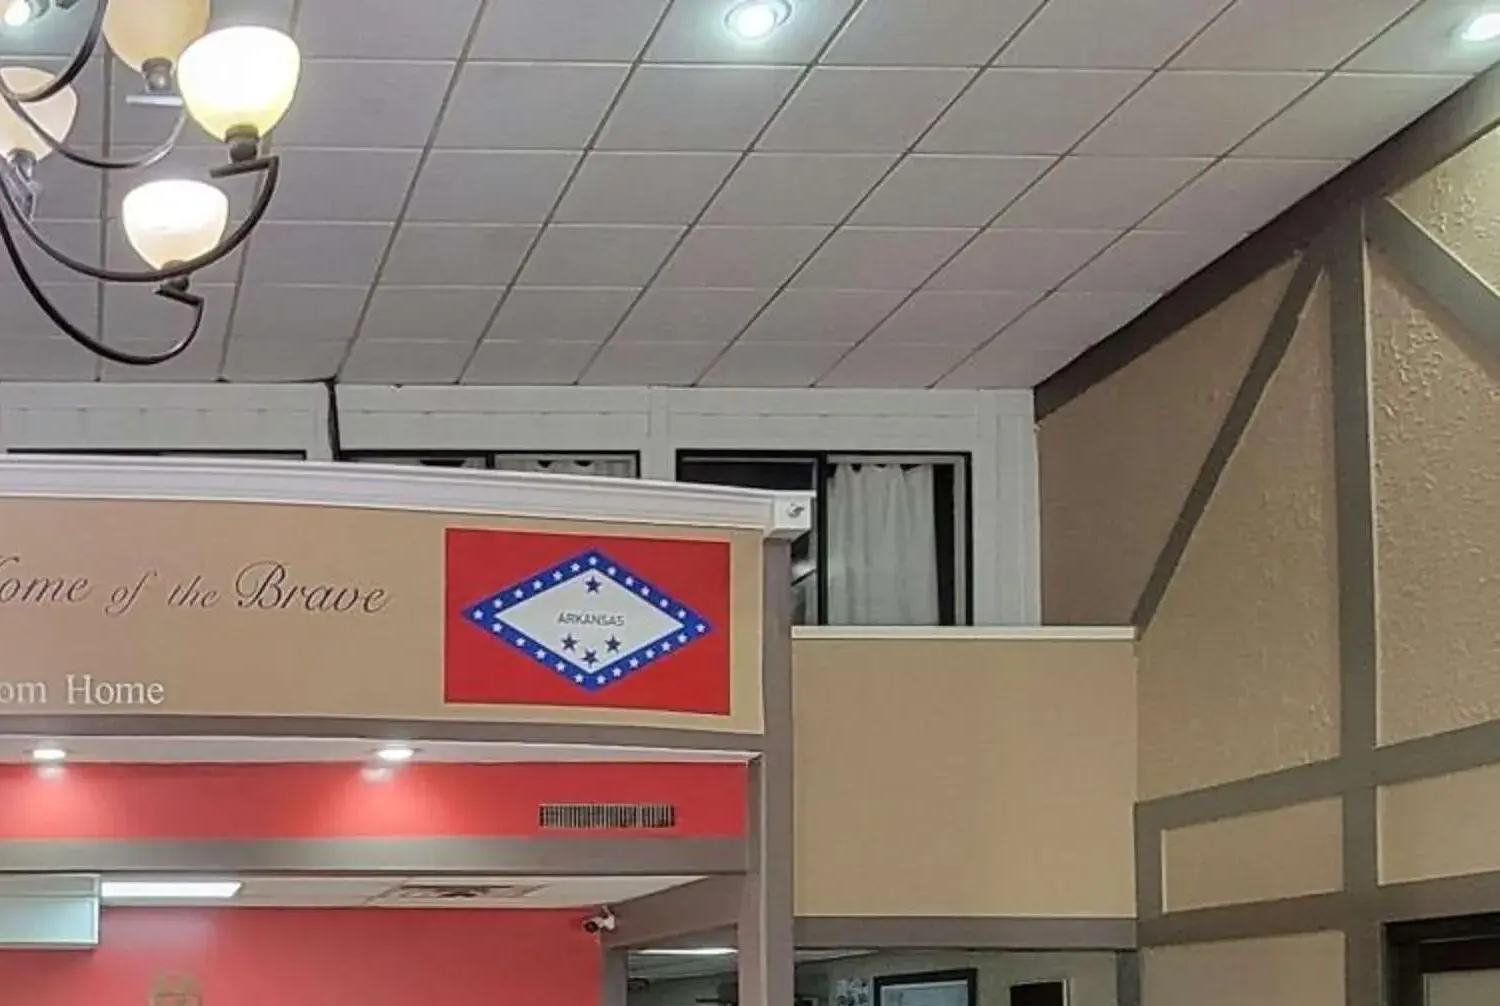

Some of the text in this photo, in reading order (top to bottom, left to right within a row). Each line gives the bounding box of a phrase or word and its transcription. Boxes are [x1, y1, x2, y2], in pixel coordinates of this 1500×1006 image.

[104, 569, 158, 616] of
[167, 574, 220, 608] the
[235, 560, 390, 615] Brave
[557, 611, 625, 627] ARKANSAS
[66, 674, 166, 705] Home
